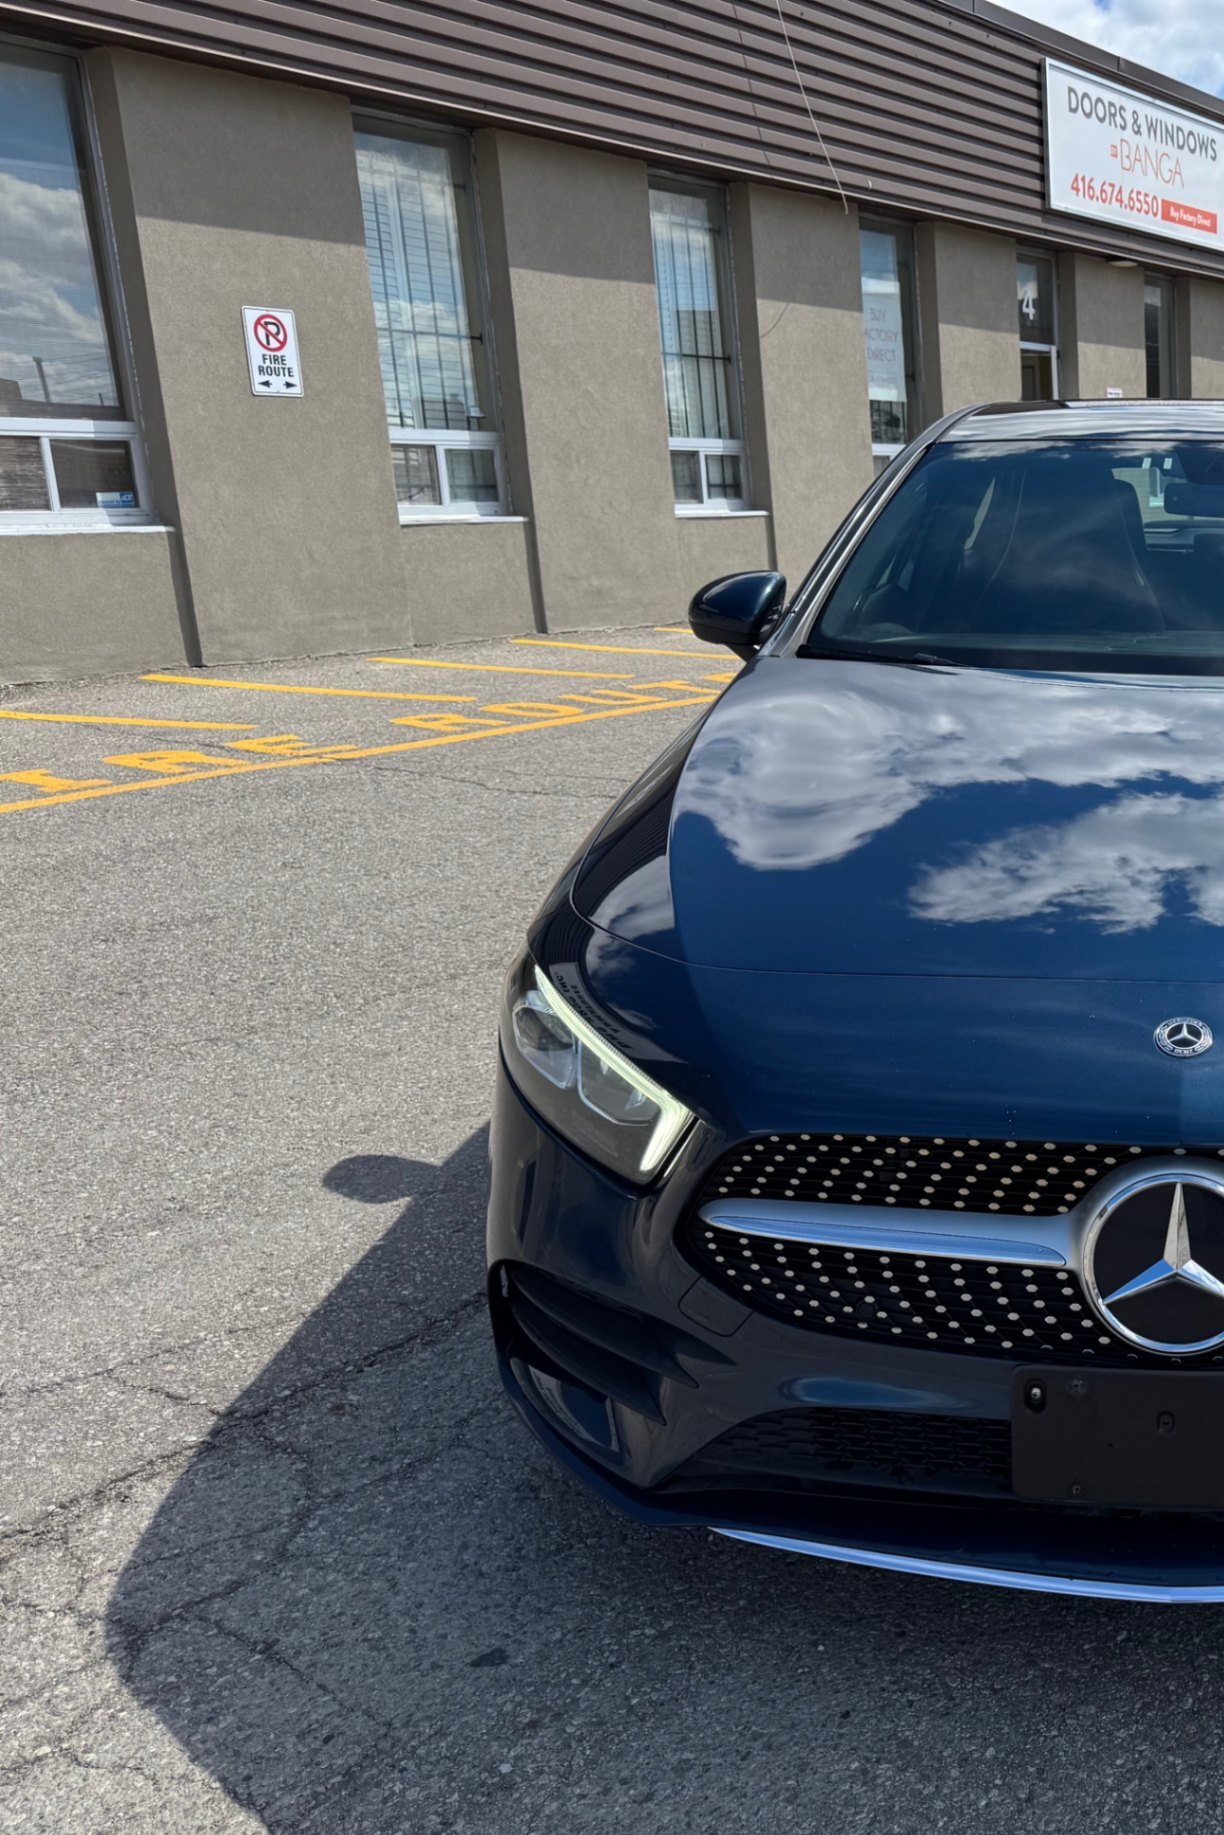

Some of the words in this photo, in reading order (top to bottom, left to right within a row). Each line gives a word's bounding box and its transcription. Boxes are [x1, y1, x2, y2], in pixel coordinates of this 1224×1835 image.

[1067, 86, 1127, 131] DOORS
[1131, 110, 1142, 137] &
[1145, 114, 1217, 162] WINDOWS
[1120, 138, 1184, 189] BANGA
[1071, 173, 1159, 218] 416.674.6550
[1170, 205, 1179, 222] Buy
[870, 307, 888, 322] BUY
[1022, 287, 1036, 321] 4
[258, 365, 294, 378] ROUTE
[261, 353, 287, 366] FIRE
